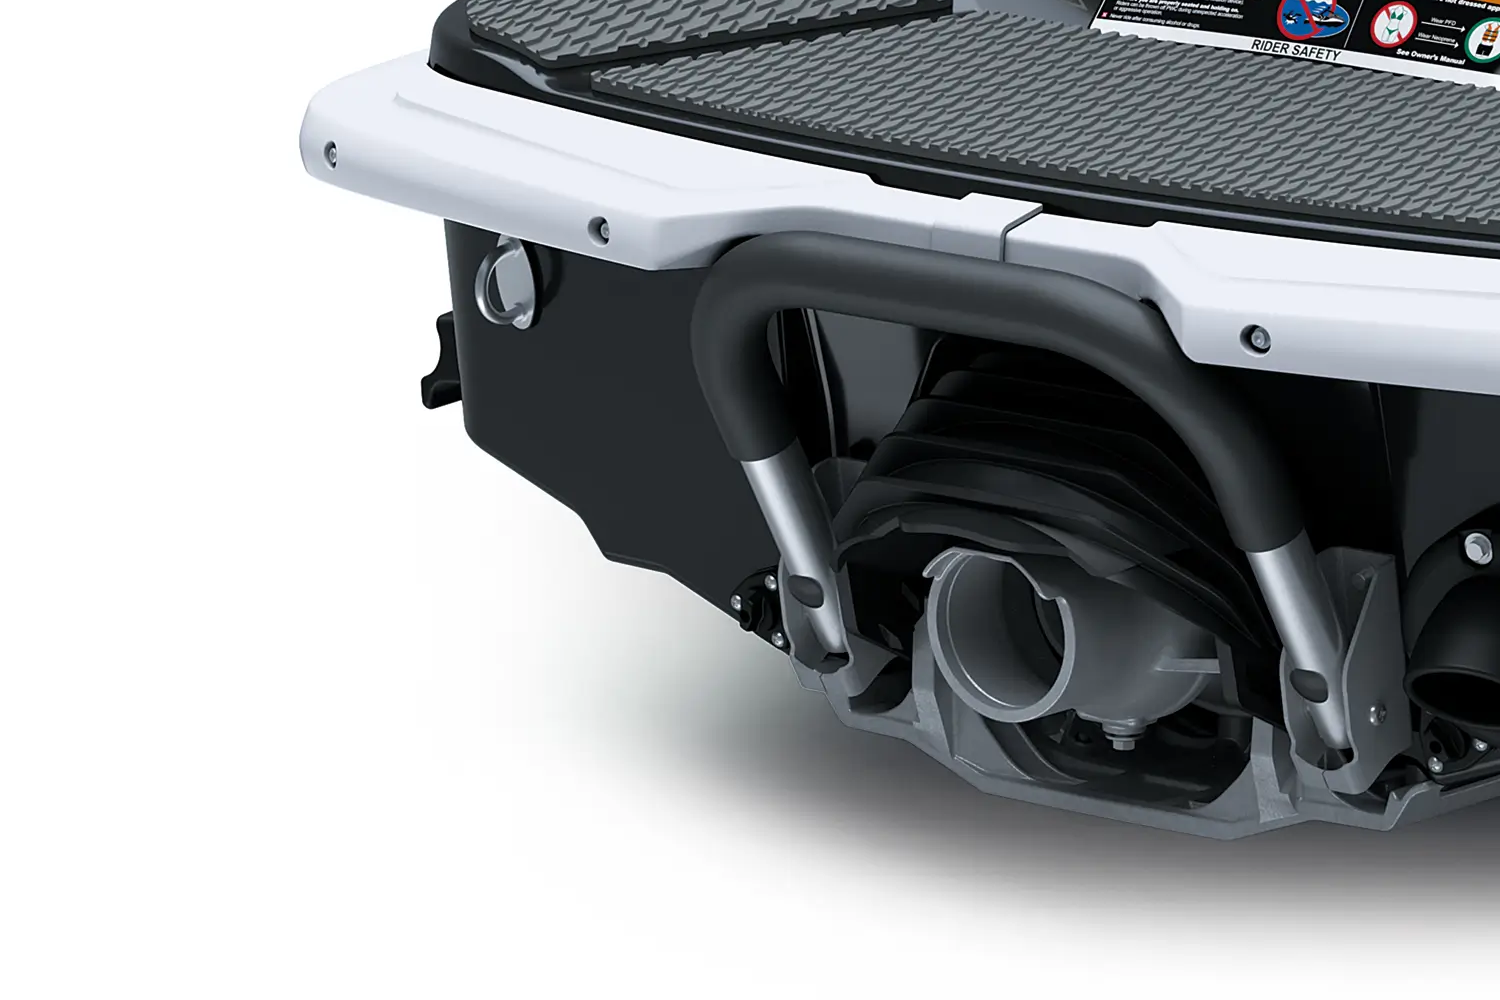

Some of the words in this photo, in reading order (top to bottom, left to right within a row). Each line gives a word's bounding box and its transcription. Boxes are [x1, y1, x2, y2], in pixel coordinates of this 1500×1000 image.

[1444, 18, 1456, 26] PFD
[1431, 34, 1455, 43] Neoprene
[1251, 38, 1289, 54] RIDER
[1291, 43, 1341, 61] SAFETY
[1396, 47, 1410, 56] See
[1410, 50, 1438, 60] Owner's
[1439, 55, 1465, 65] Manual
